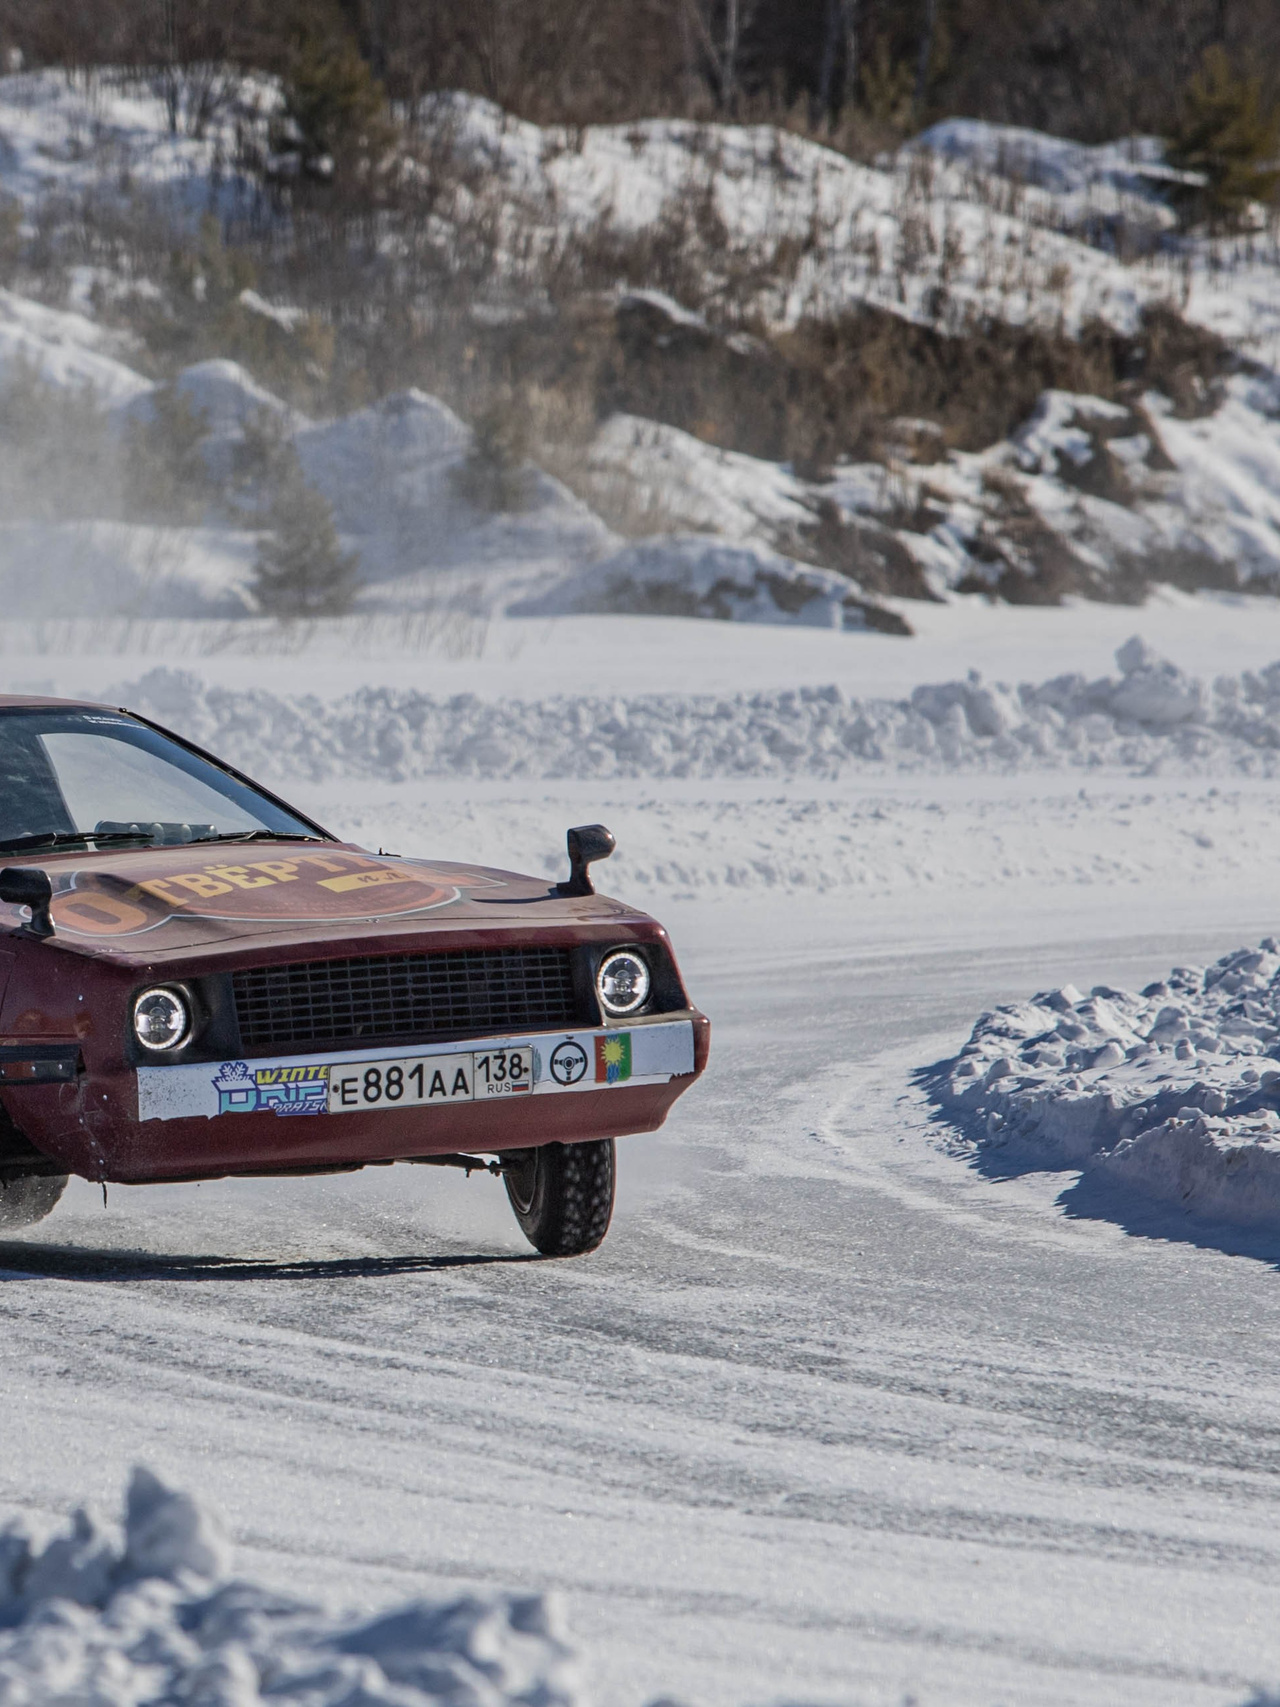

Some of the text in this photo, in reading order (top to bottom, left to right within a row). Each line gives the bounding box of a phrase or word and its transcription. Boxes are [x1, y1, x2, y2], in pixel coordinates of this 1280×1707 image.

[256, 1066, 328, 1085] WINTE
[340, 1053, 523, 1106] Е881АА 138
[487, 1082, 511, 1094] RUS
